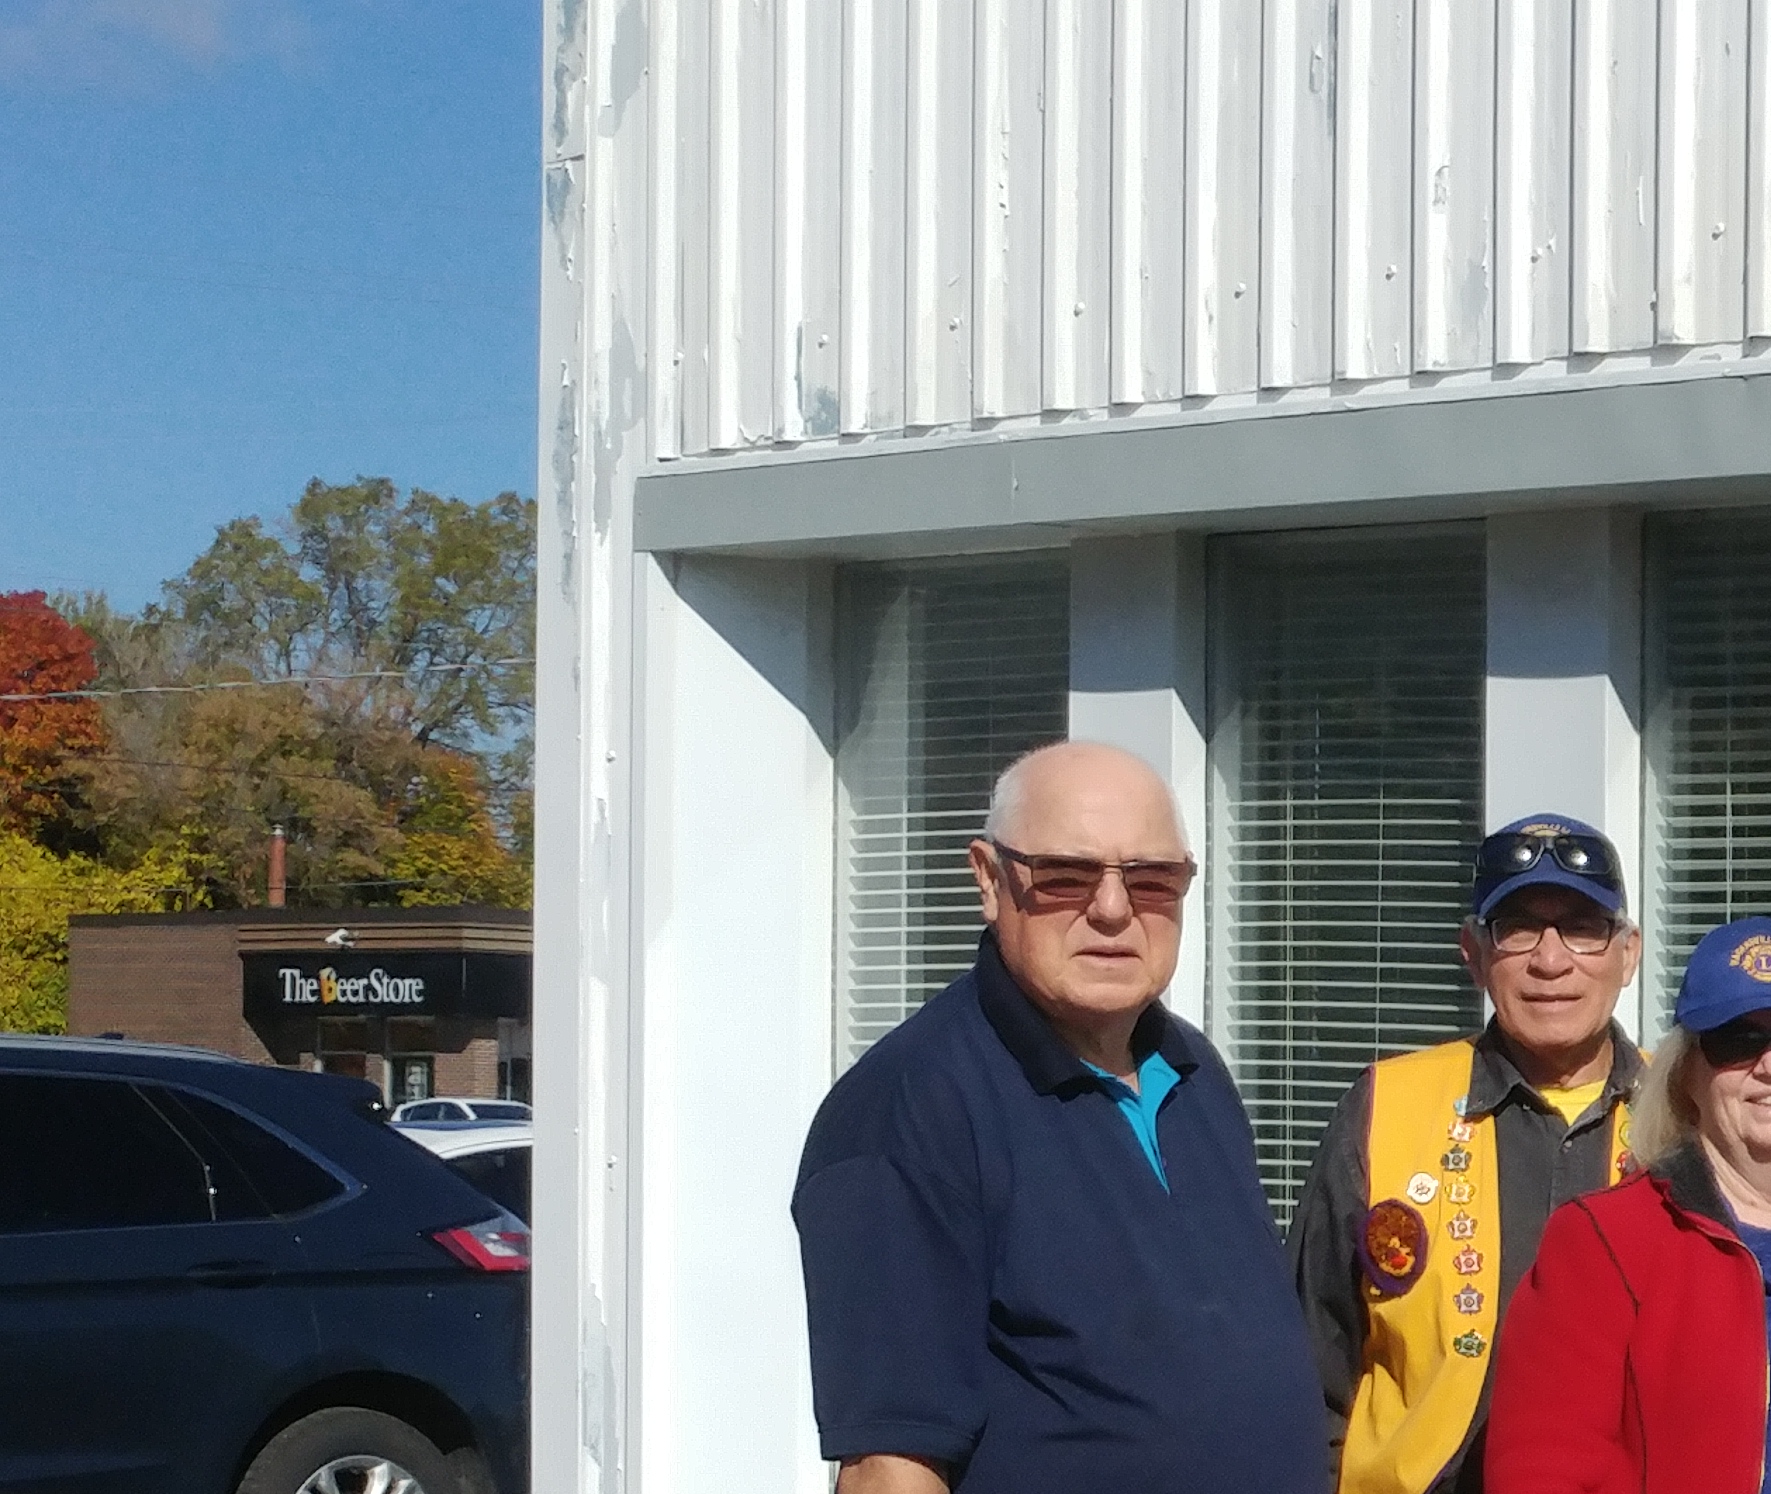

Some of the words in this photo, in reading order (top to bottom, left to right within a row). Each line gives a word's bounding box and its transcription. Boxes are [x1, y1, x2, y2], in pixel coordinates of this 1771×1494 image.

[279, 968, 319, 1003] The
[319, 967, 369, 1005] Beer
[368, 968, 425, 1003] Store
